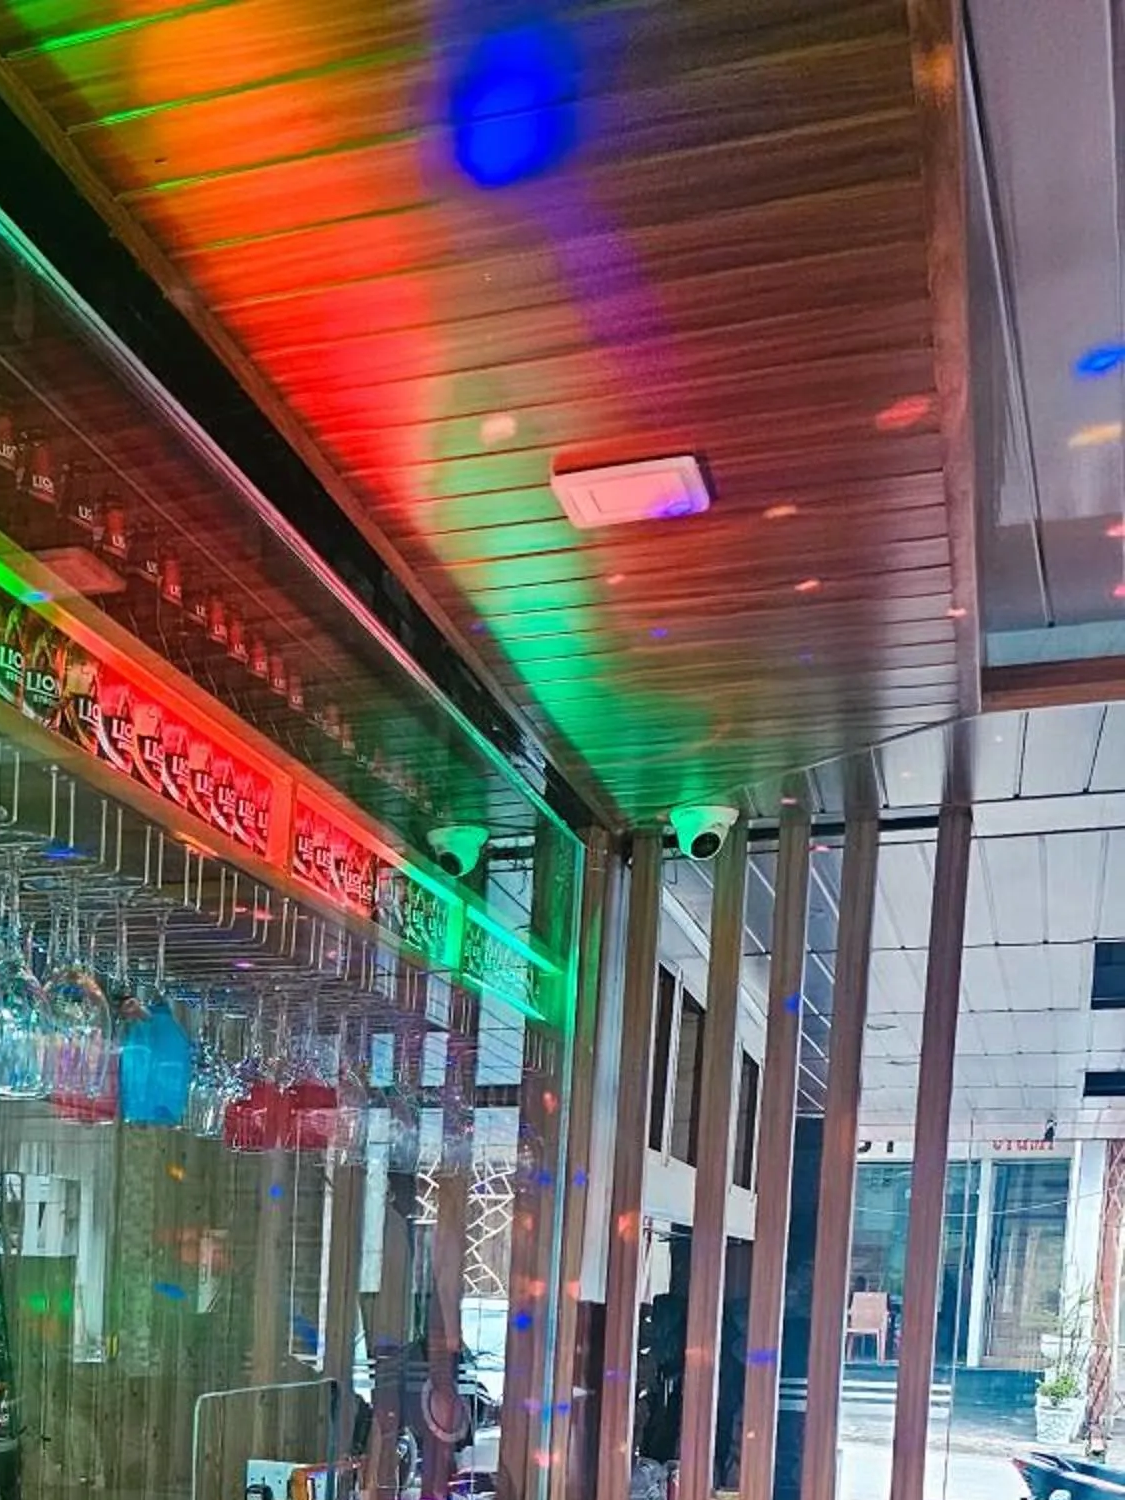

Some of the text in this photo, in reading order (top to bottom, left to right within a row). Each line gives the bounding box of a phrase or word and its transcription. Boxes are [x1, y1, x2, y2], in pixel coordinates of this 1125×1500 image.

[0, 646, 23, 675] LIO
[79, 698, 102, 727] LIO
[112, 719, 134, 742] LIO
[144, 739, 165, 763] LIO
